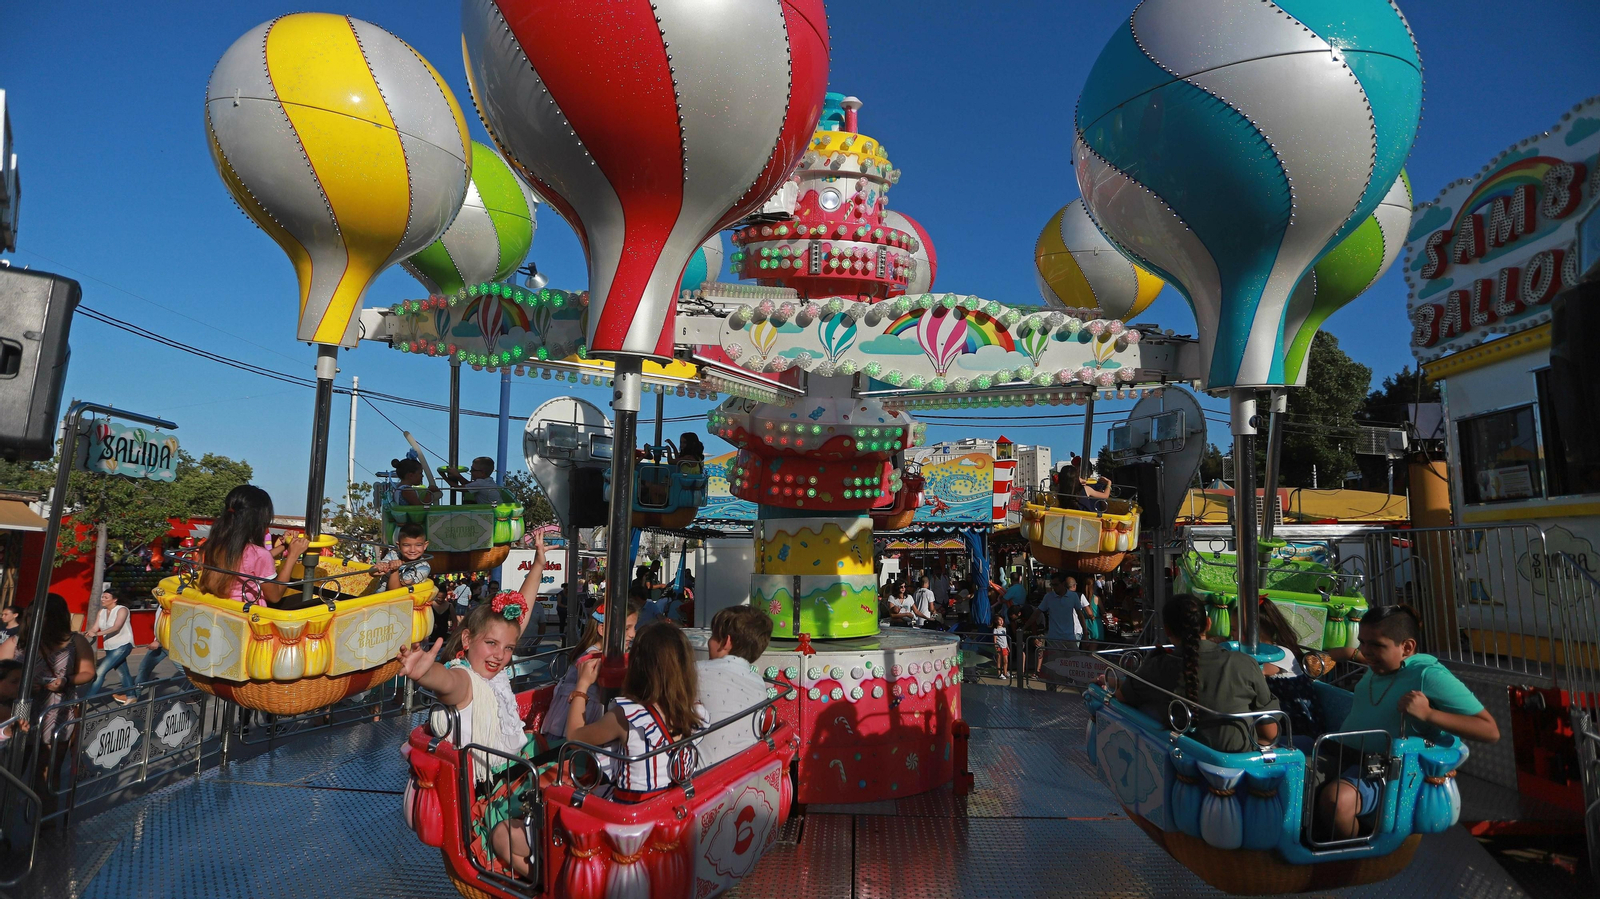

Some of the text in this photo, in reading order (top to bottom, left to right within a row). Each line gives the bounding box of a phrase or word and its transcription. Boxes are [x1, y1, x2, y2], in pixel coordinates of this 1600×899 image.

[1420, 157, 1600, 280] SAMB
[97, 435, 170, 469] SALIDA
[517, 560, 561, 570] Aldón
[193, 626, 211, 658] 5
[359, 624, 398, 641] SAMBA
[164, 710, 190, 738] SALIDA
[97, 726, 130, 758] SALIDA
[1407, 772, 1417, 788] 7
[732, 805, 756, 855] 6
